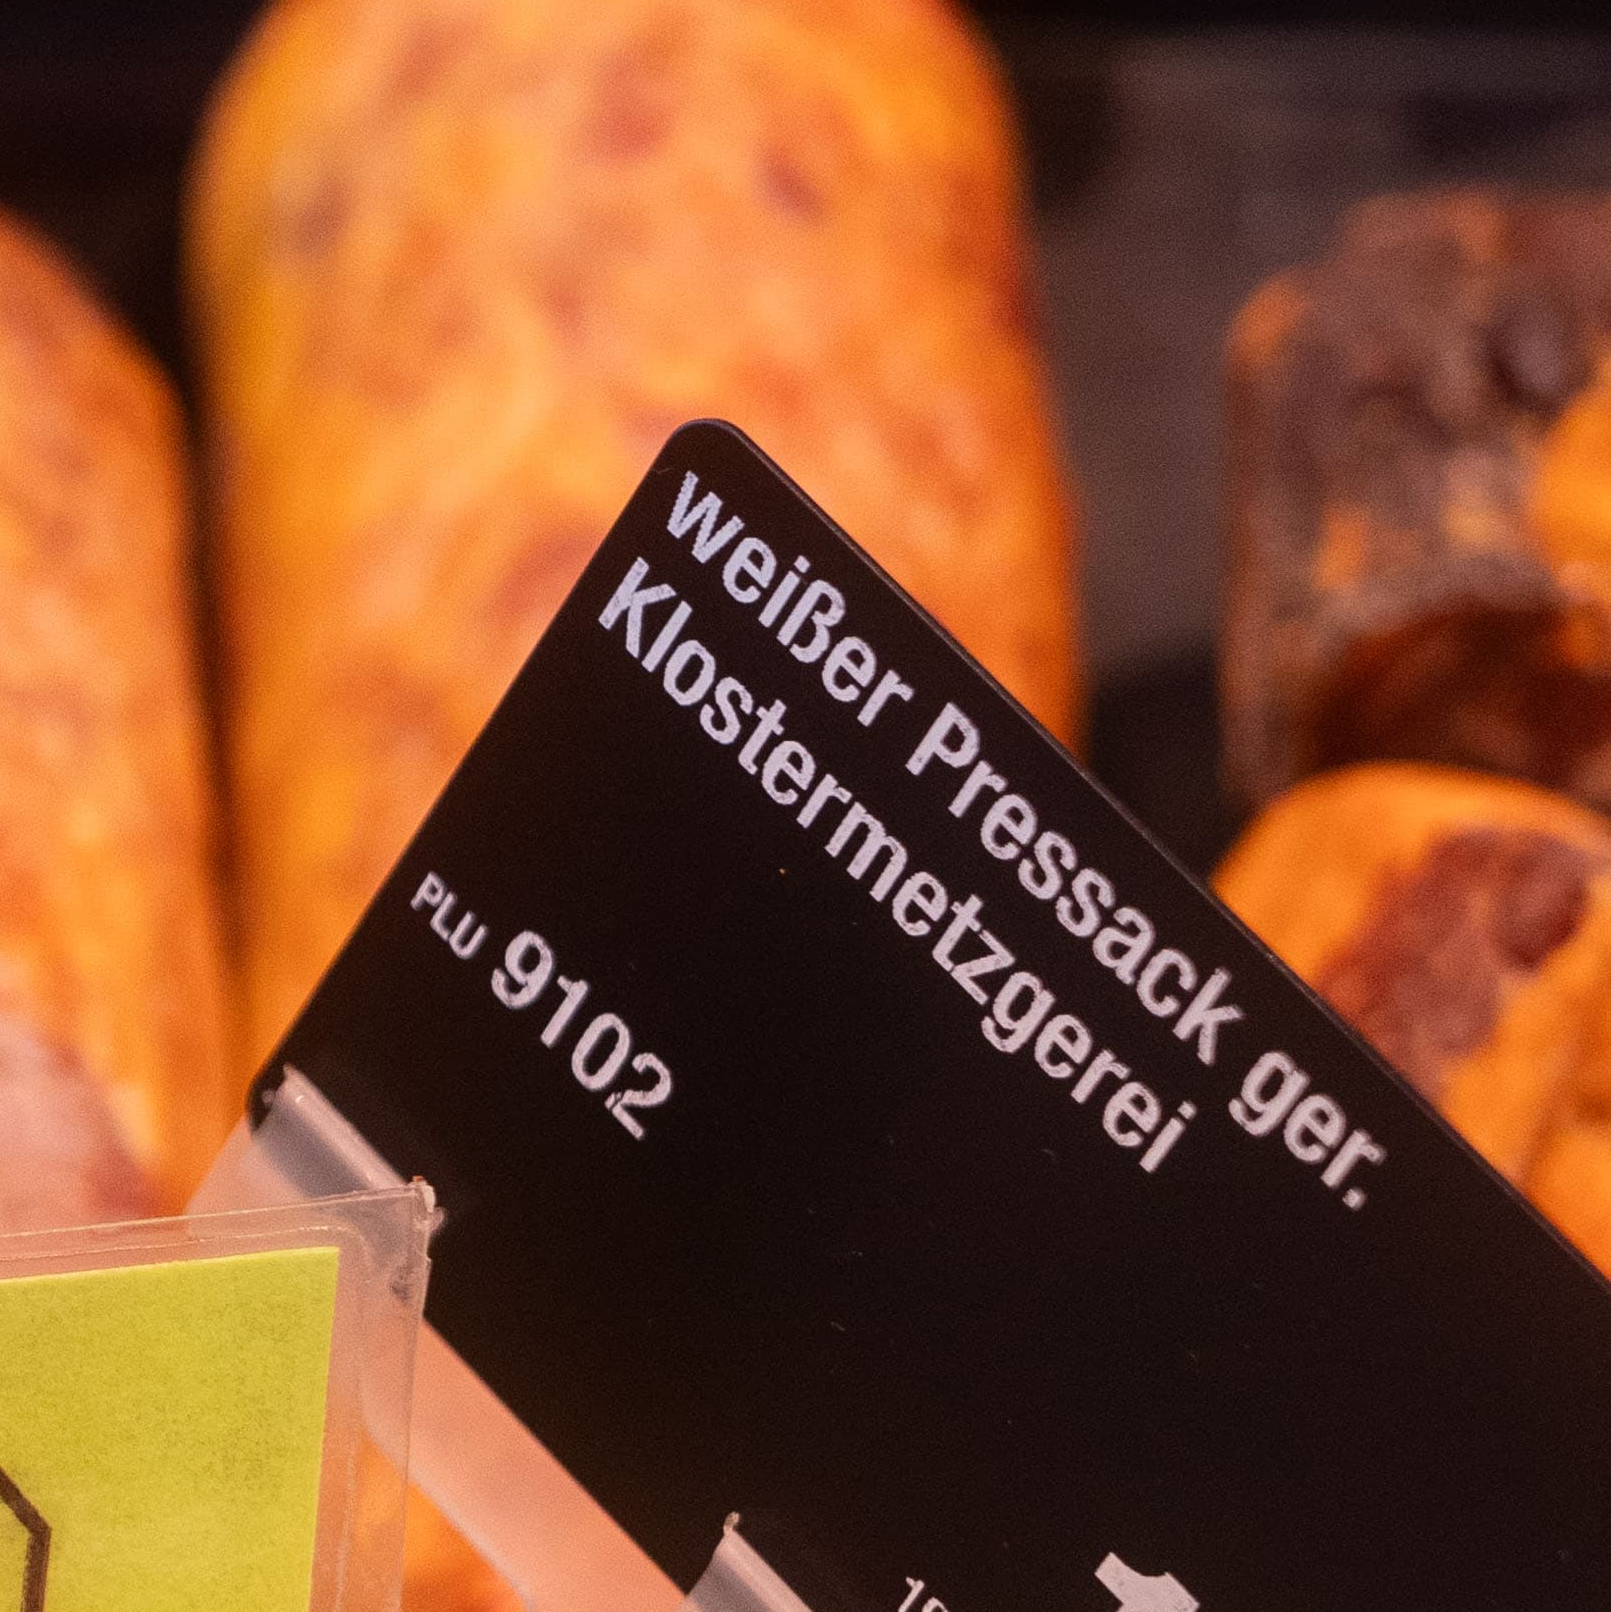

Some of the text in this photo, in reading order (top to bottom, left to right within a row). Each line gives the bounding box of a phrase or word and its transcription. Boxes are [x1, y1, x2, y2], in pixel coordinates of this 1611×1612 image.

[409, 871, 674, 1140] PLU 9102
[598, 555, 1198, 1175] Klostermetzgerei
[666, 470, 1386, 1210] weißer Pressack ger.
